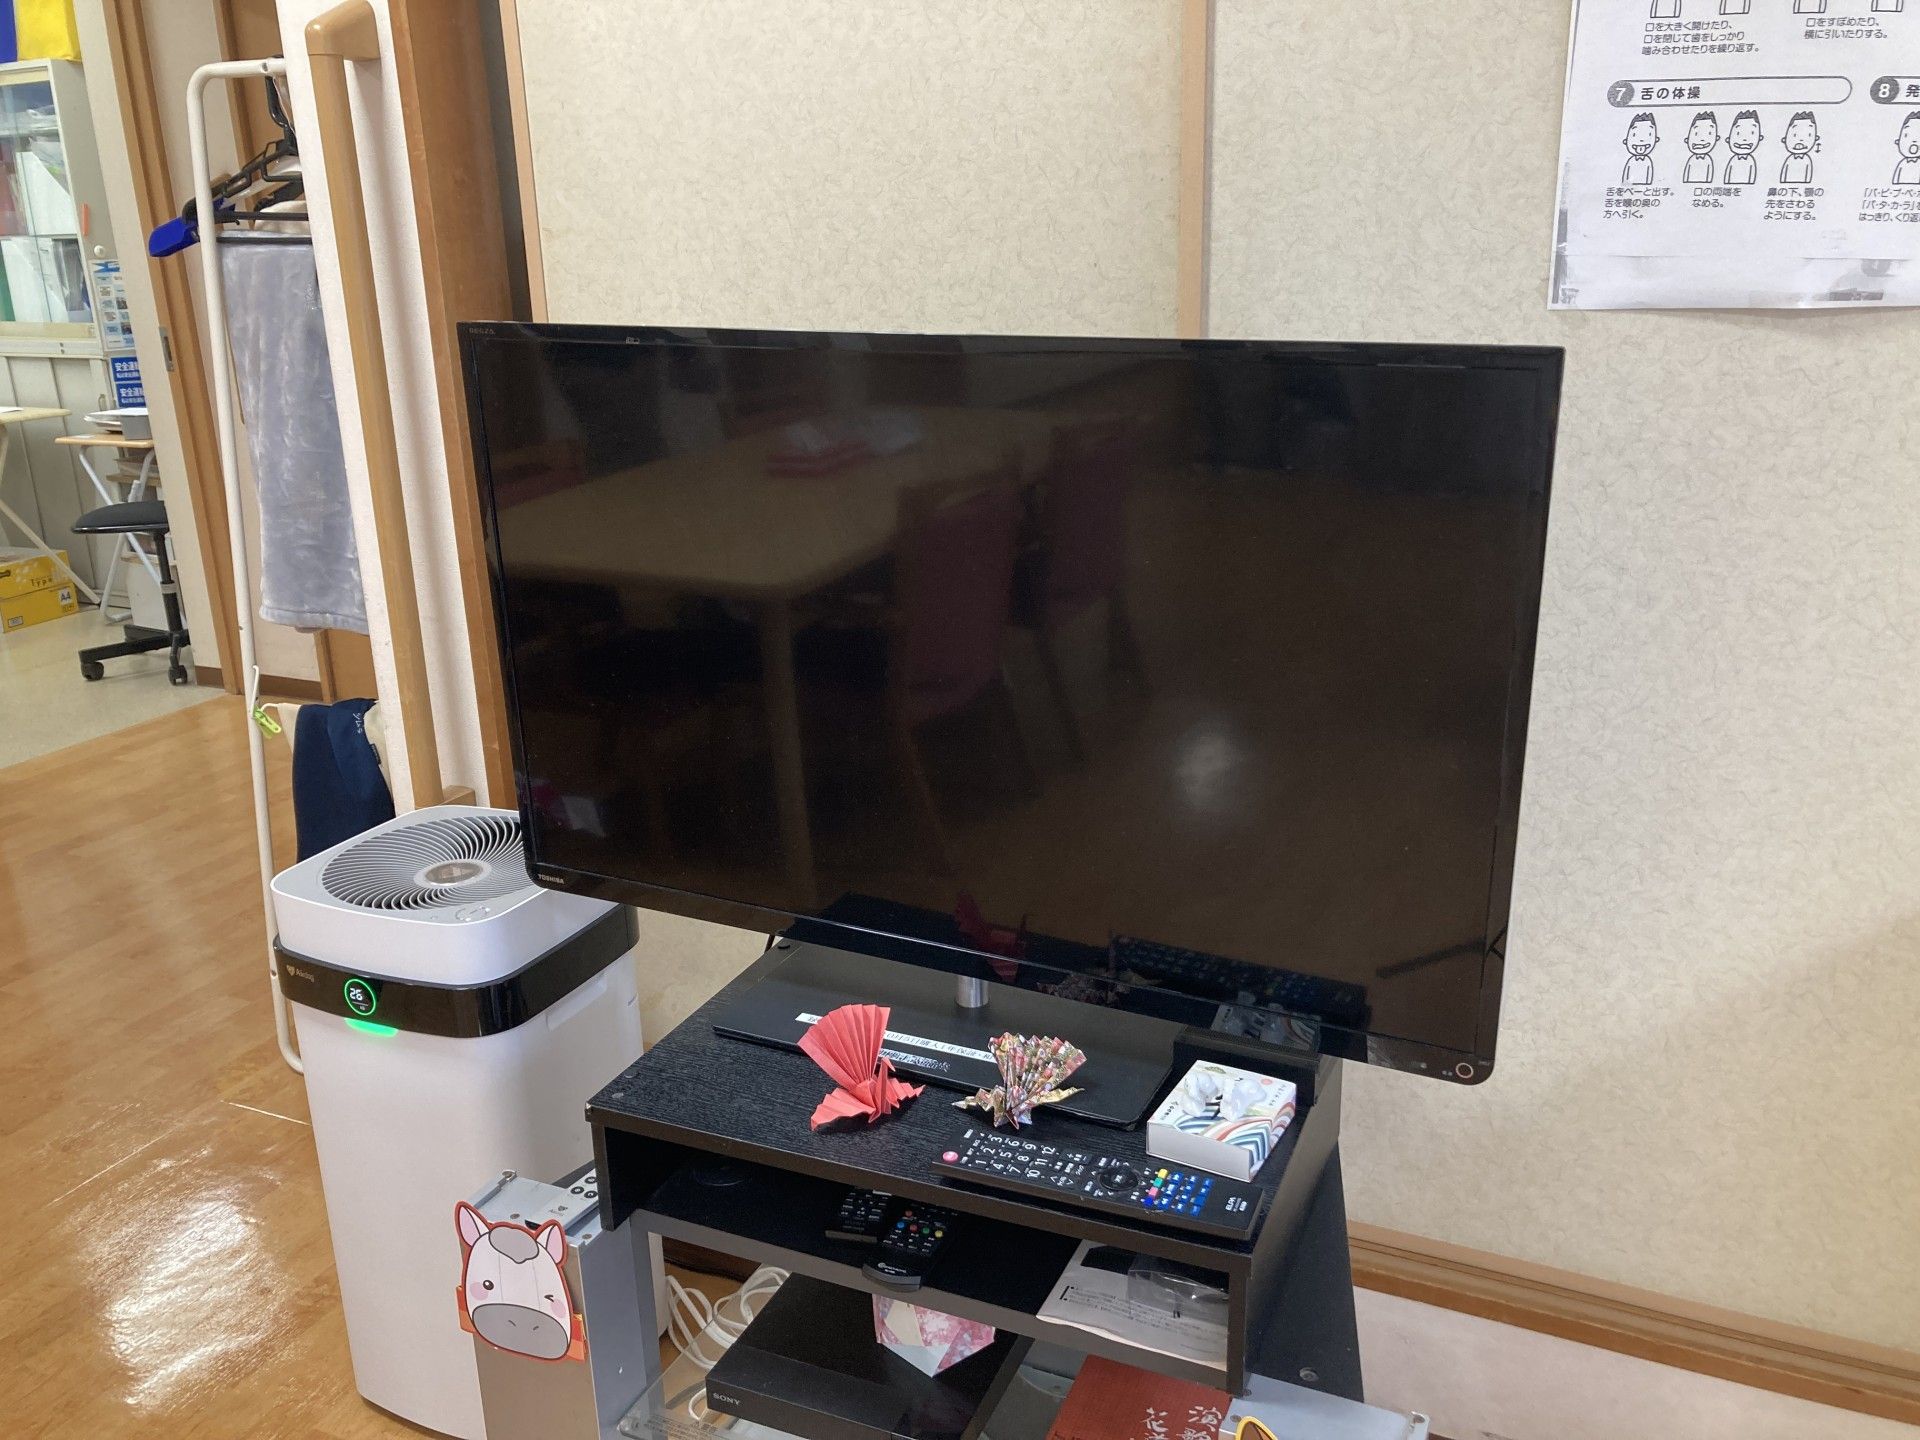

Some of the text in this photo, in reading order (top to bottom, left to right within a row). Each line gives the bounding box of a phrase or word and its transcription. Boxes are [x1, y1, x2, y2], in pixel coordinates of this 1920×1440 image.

[1645, 20, 1732, 32] 口を大きく開けたり、
[1806, 16, 1880, 27] 口をすぼめたり、
[1643, 31, 1745, 43] 口を閉じて歯をしっかり
[1804, 29, 1888, 39] 横に引いたりする。
[1615, 85, 1701, 102] 7 舌の体操
[1879, 83, 1920, 98] 8 発
[1693, 187, 1742, 197] 口の両端を
[1692, 198, 1724, 208] なめる。
[1764, 199, 1816, 209] 先をさわる
[1602, 209, 1644, 219] 方へ引く。
[1763, 210, 1816, 221] ようにする。
[1858, 212, 1920, 222] はっきり、くり返
[349, 987, 363, 1001] 26
[713, 1392, 740, 1405] SONY
